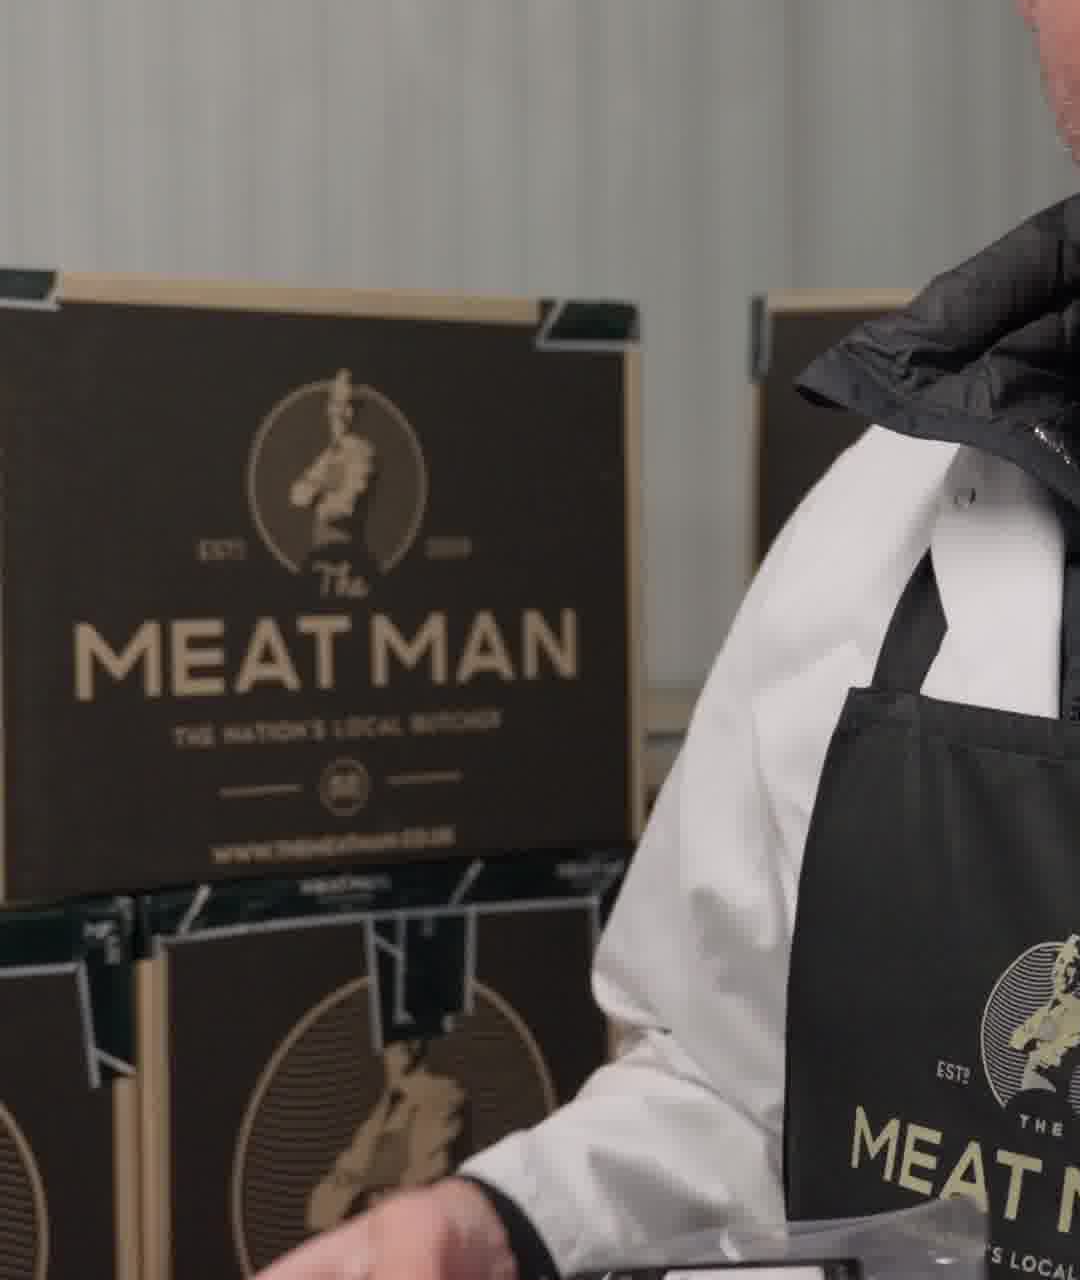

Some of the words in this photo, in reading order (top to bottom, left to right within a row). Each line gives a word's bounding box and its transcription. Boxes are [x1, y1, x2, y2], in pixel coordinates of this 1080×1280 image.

[73, 616, 353, 702] MEAT
[370, 608, 578, 688] MAN
[173, 723, 215, 749] THE
[1019, 1113, 1064, 1137] THE
[850, 1105, 1043, 1220] MEAT
